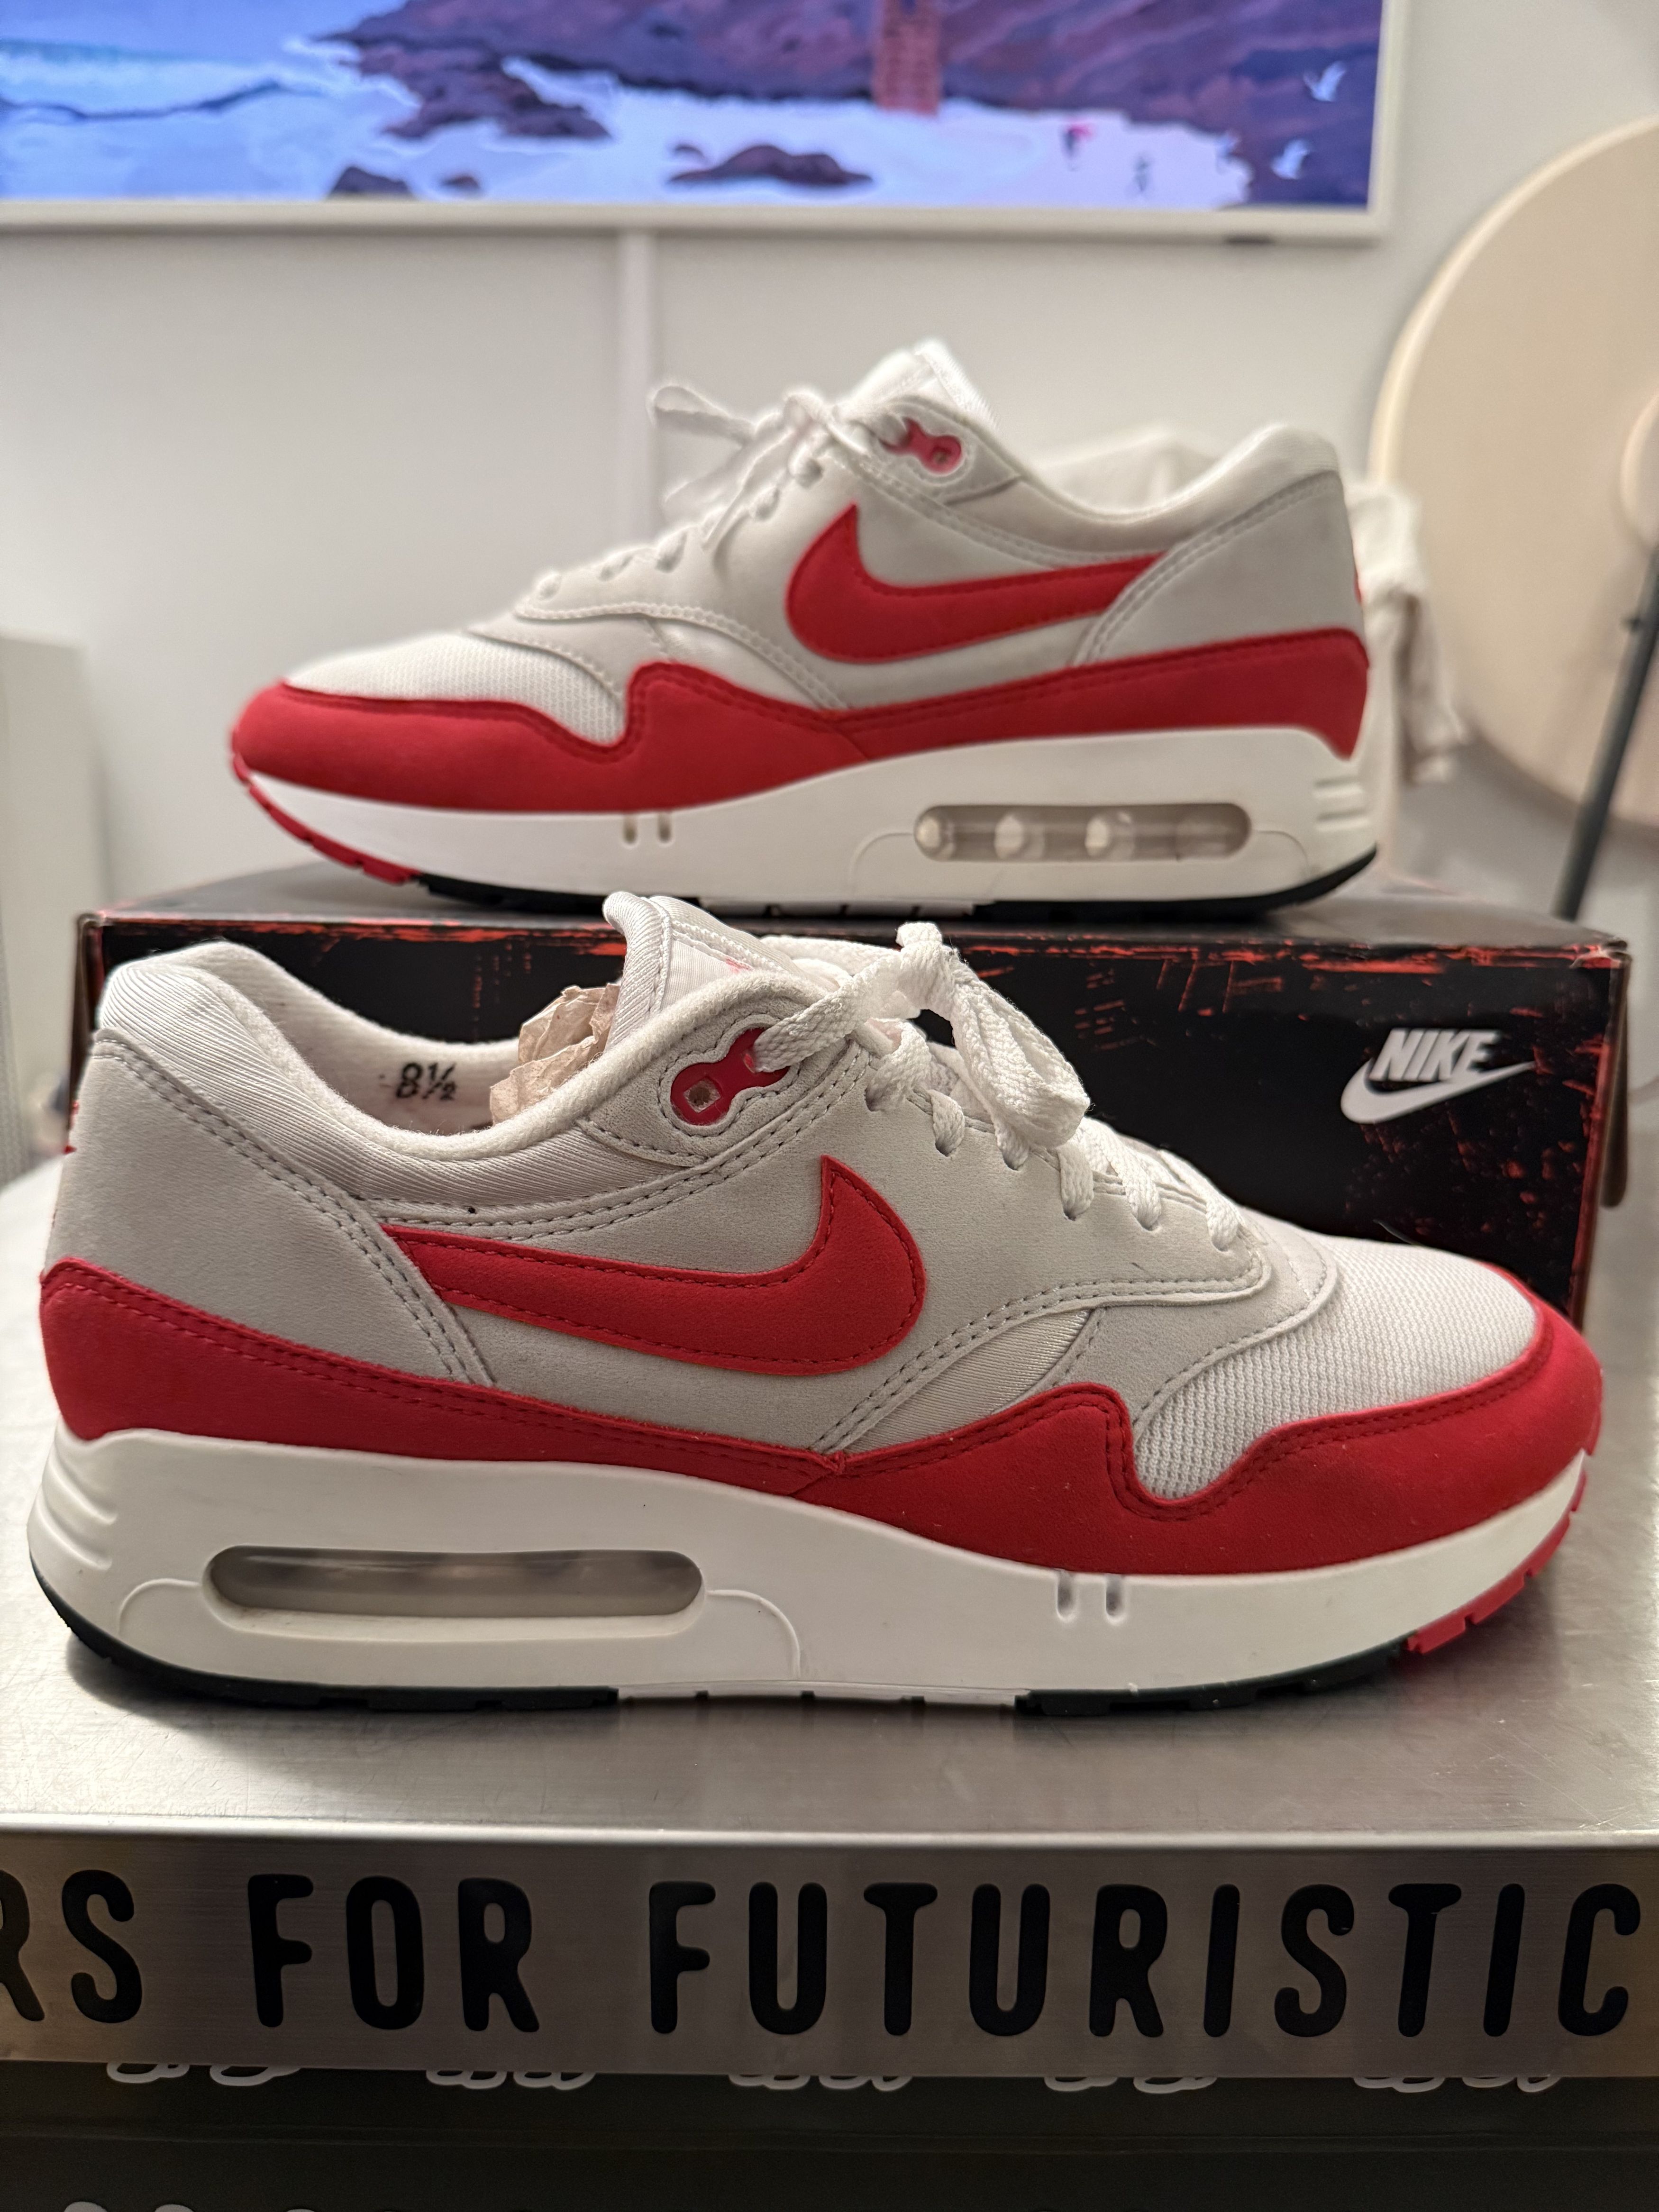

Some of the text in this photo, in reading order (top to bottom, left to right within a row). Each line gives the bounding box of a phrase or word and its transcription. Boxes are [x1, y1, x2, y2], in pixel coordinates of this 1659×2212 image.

[1368, 1027, 1502, 1083] NIKE
[243, 1872, 540, 2033] FOR
[648, 1881, 1641, 2038] FUTURISTIC
